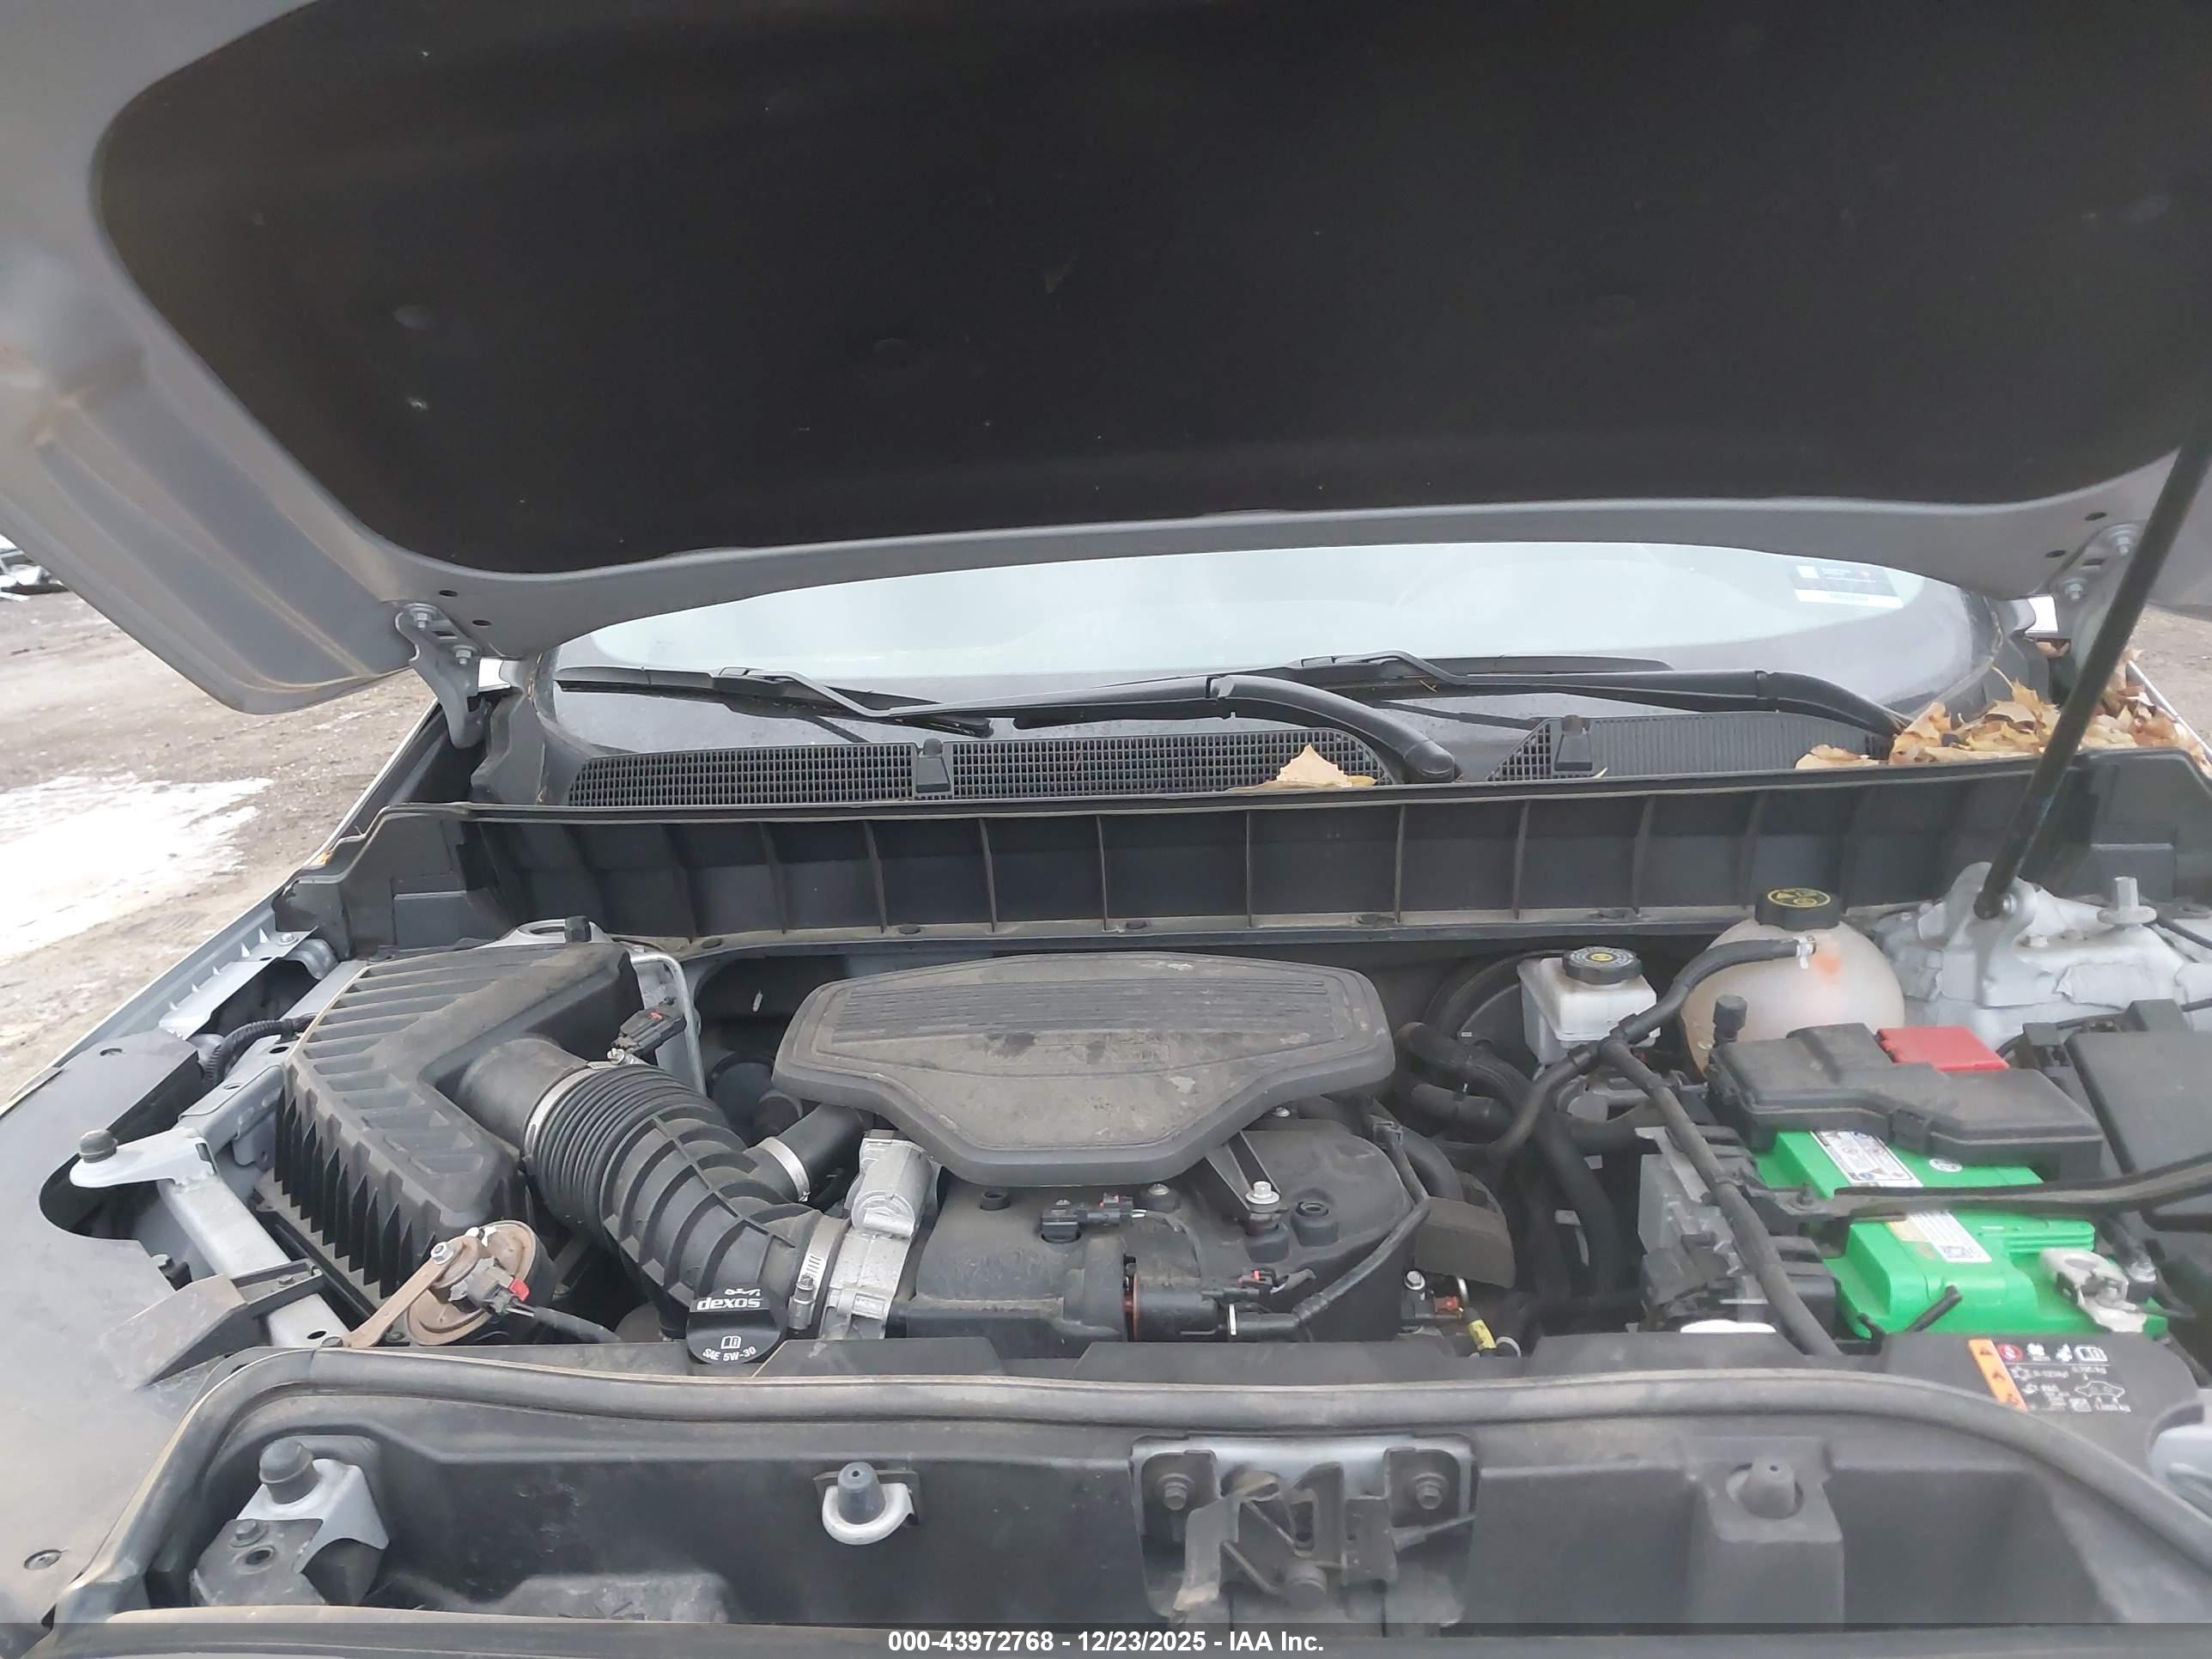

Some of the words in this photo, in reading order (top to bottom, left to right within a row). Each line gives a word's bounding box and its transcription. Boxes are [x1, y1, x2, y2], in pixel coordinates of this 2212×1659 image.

[697, 1297, 763, 1310] dexos
[702, 1348, 721, 1361] SAE
[723, 1346, 757, 1362] 5W-30
